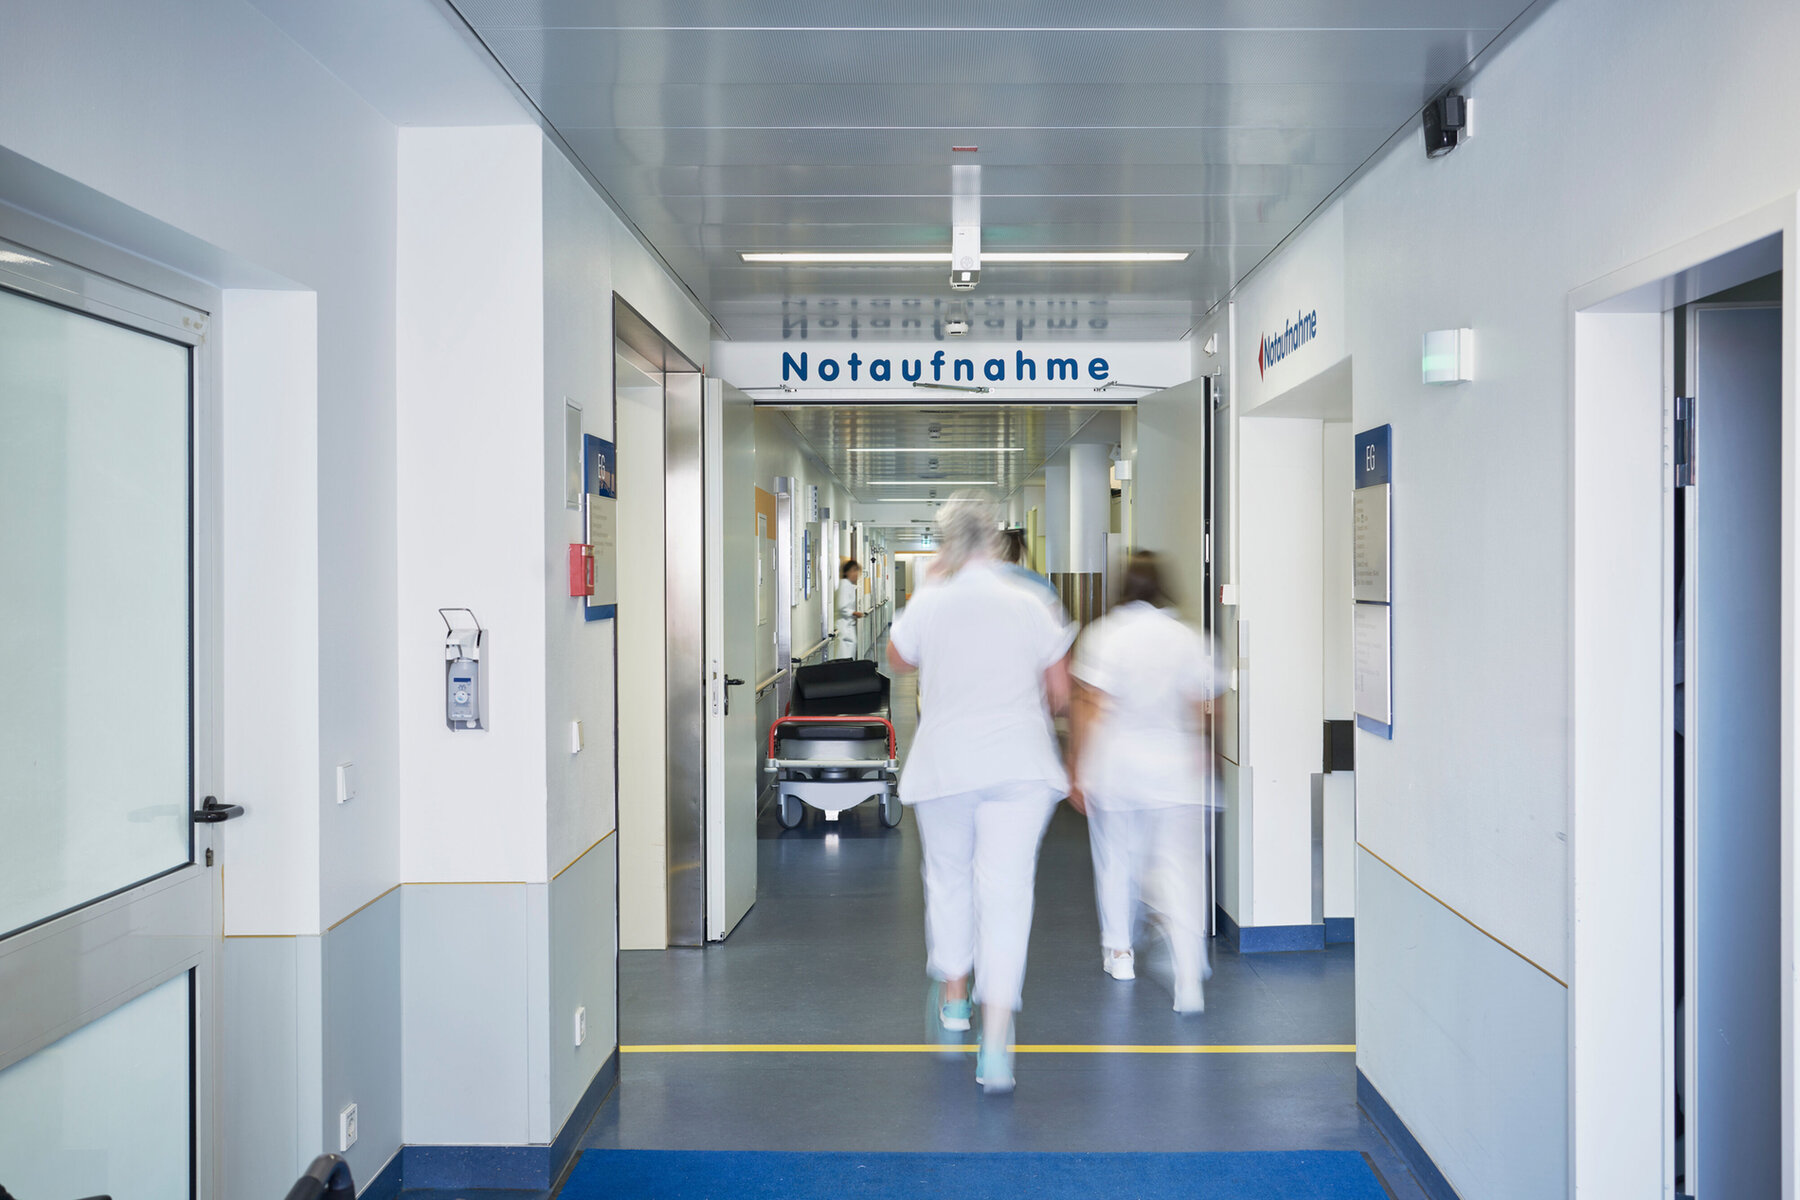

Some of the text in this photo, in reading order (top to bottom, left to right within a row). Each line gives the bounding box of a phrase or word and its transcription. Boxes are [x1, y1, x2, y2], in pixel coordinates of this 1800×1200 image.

[1264, 309, 1317, 371] Notaufnahme
[782, 350, 1109, 382] Notaufnahme
[597, 453, 605, 480] EG
[1366, 444, 1376, 472] EG
